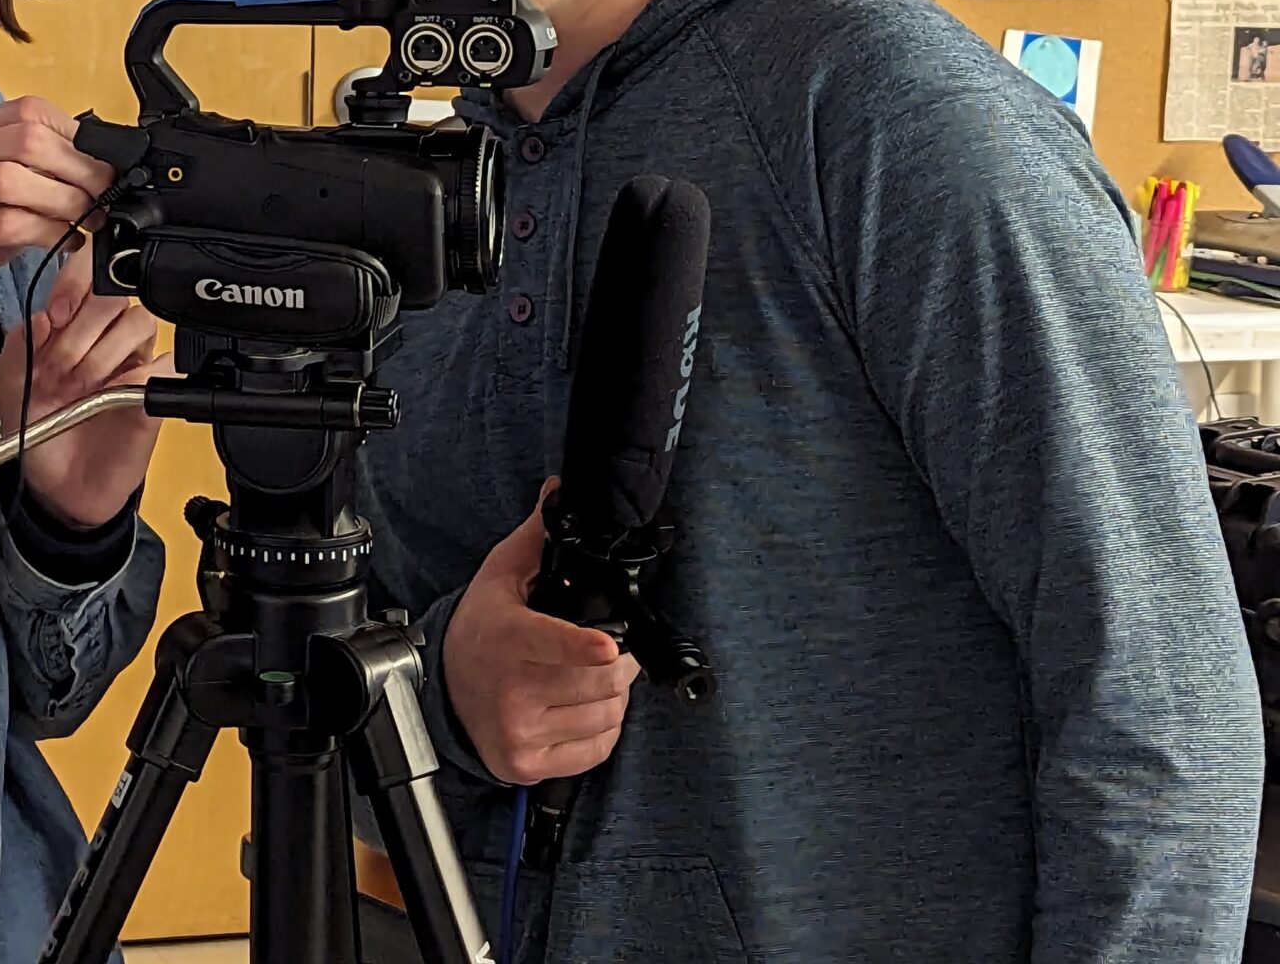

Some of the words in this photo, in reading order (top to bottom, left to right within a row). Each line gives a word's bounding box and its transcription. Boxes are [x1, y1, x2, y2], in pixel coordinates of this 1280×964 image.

[414, 15, 436, 23] INPUT
[472, 16, 494, 24] INPUT
[195, 278, 305, 310] Canon
